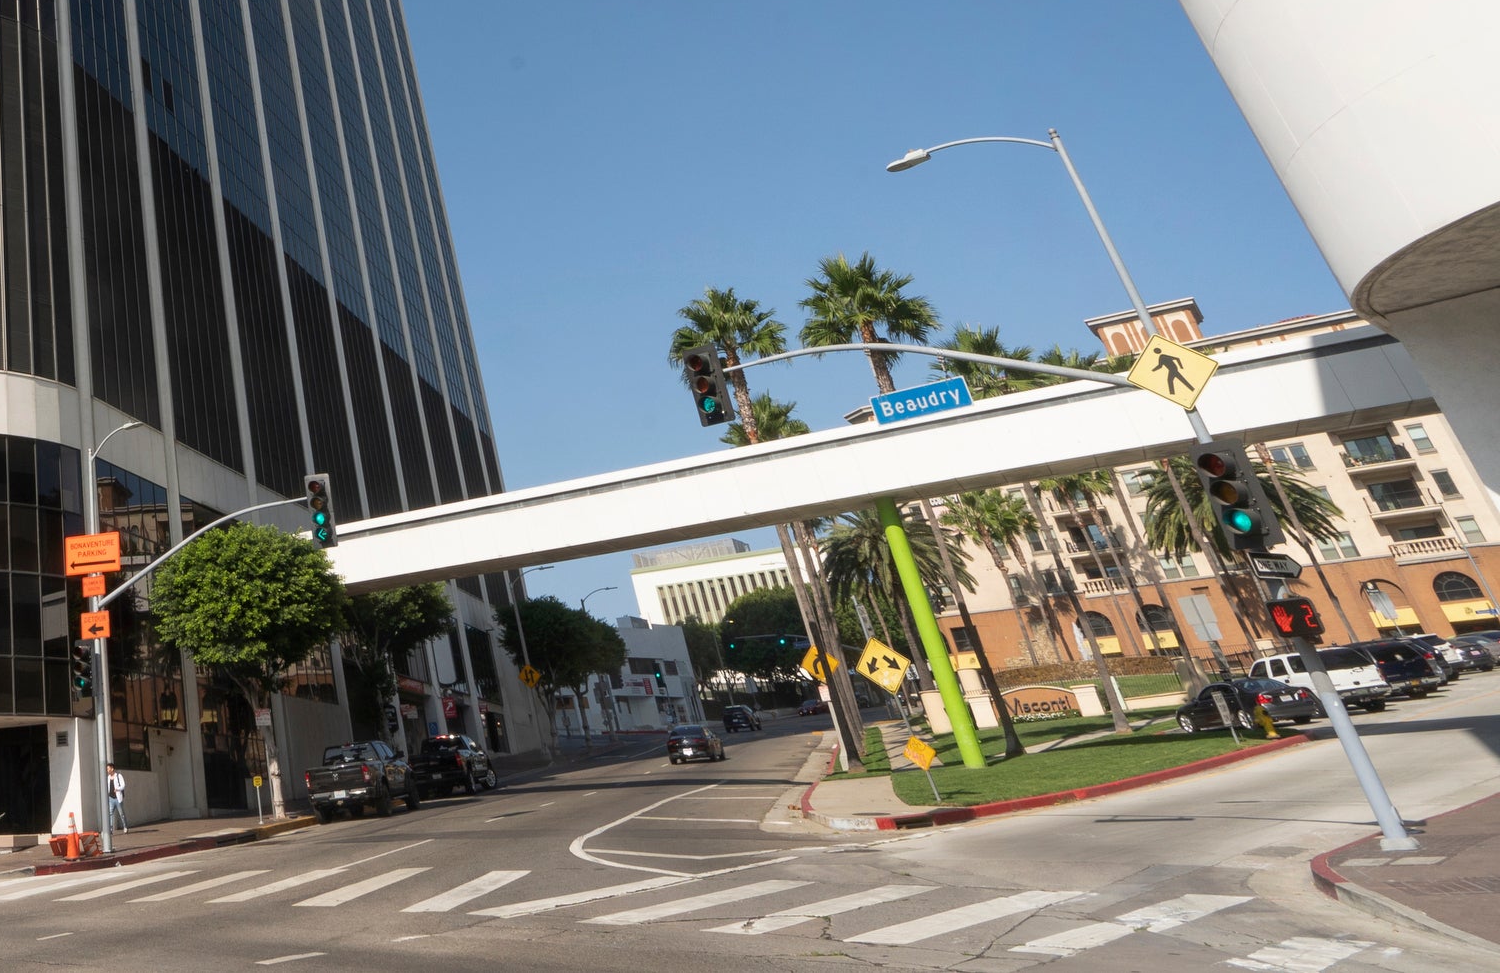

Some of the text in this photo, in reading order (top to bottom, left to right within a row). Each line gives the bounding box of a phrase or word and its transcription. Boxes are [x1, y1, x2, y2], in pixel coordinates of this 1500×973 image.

[880, 388, 960, 417] Beaudry
[70, 539, 115, 550] BONAVENTURE
[77, 549, 107, 558] PARKING
[1300, 604, 1318, 627] 2
[1004, 695, 1072, 716] Visconti
